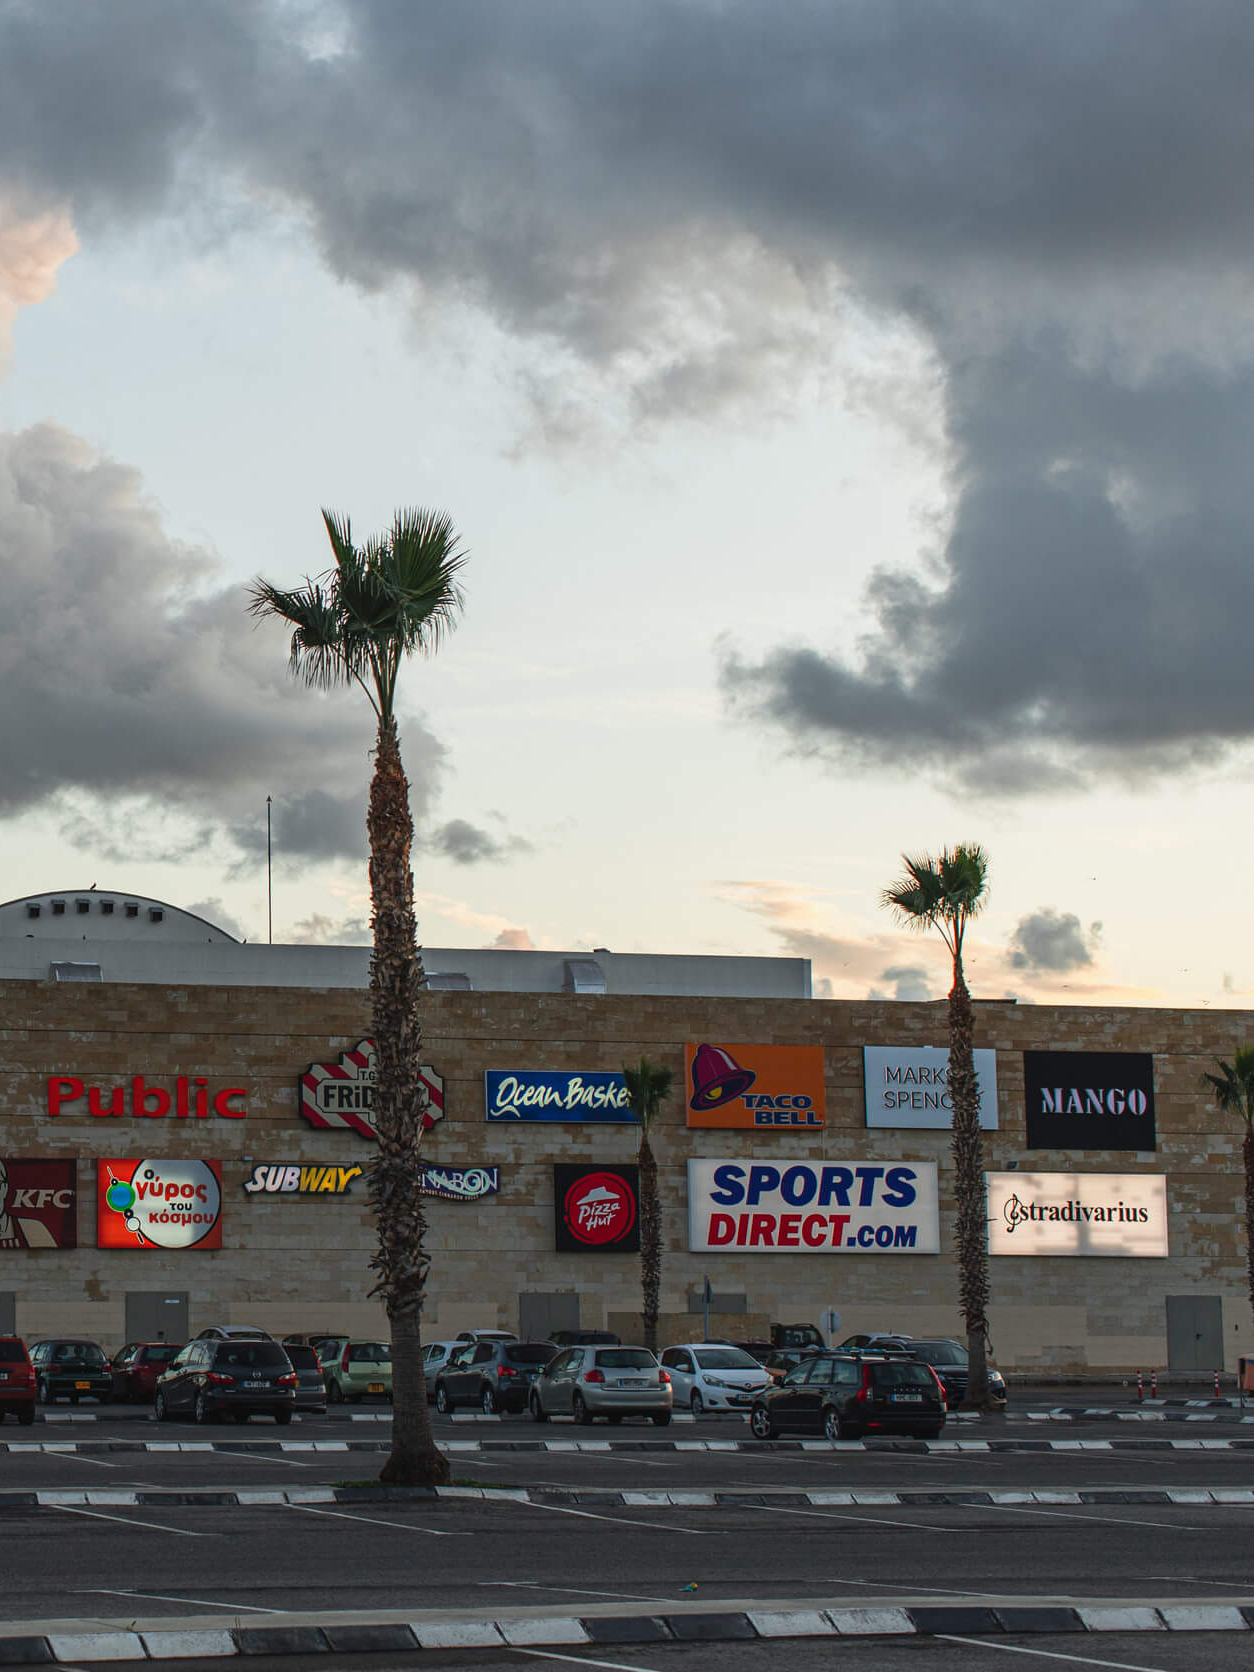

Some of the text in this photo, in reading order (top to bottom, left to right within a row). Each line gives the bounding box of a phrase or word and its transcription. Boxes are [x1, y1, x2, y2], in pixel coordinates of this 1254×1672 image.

[47, 1076, 247, 1119] Public
[491, 1077, 632, 1117] Ocean Baske
[740, 1094, 813, 1110] TACO
[883, 1090, 956, 1110] SPENC
[1040, 1087, 1147, 1116] MANGO
[754, 1110, 824, 1126] BELL
[135, 1176, 208, 1203] γύρος
[246, 1165, 362, 1193] SUBWAY
[418, 1167, 498, 1194] NABON
[709, 1165, 918, 1208] SPORTS
[11, 1188, 73, 1209] KFC
[169, 1202, 193, 1211] του
[148, 1208, 214, 1227] κόσμου
[586, 1213, 617, 1231] Hut
[1011, 1199, 1149, 1223] stradivarius
